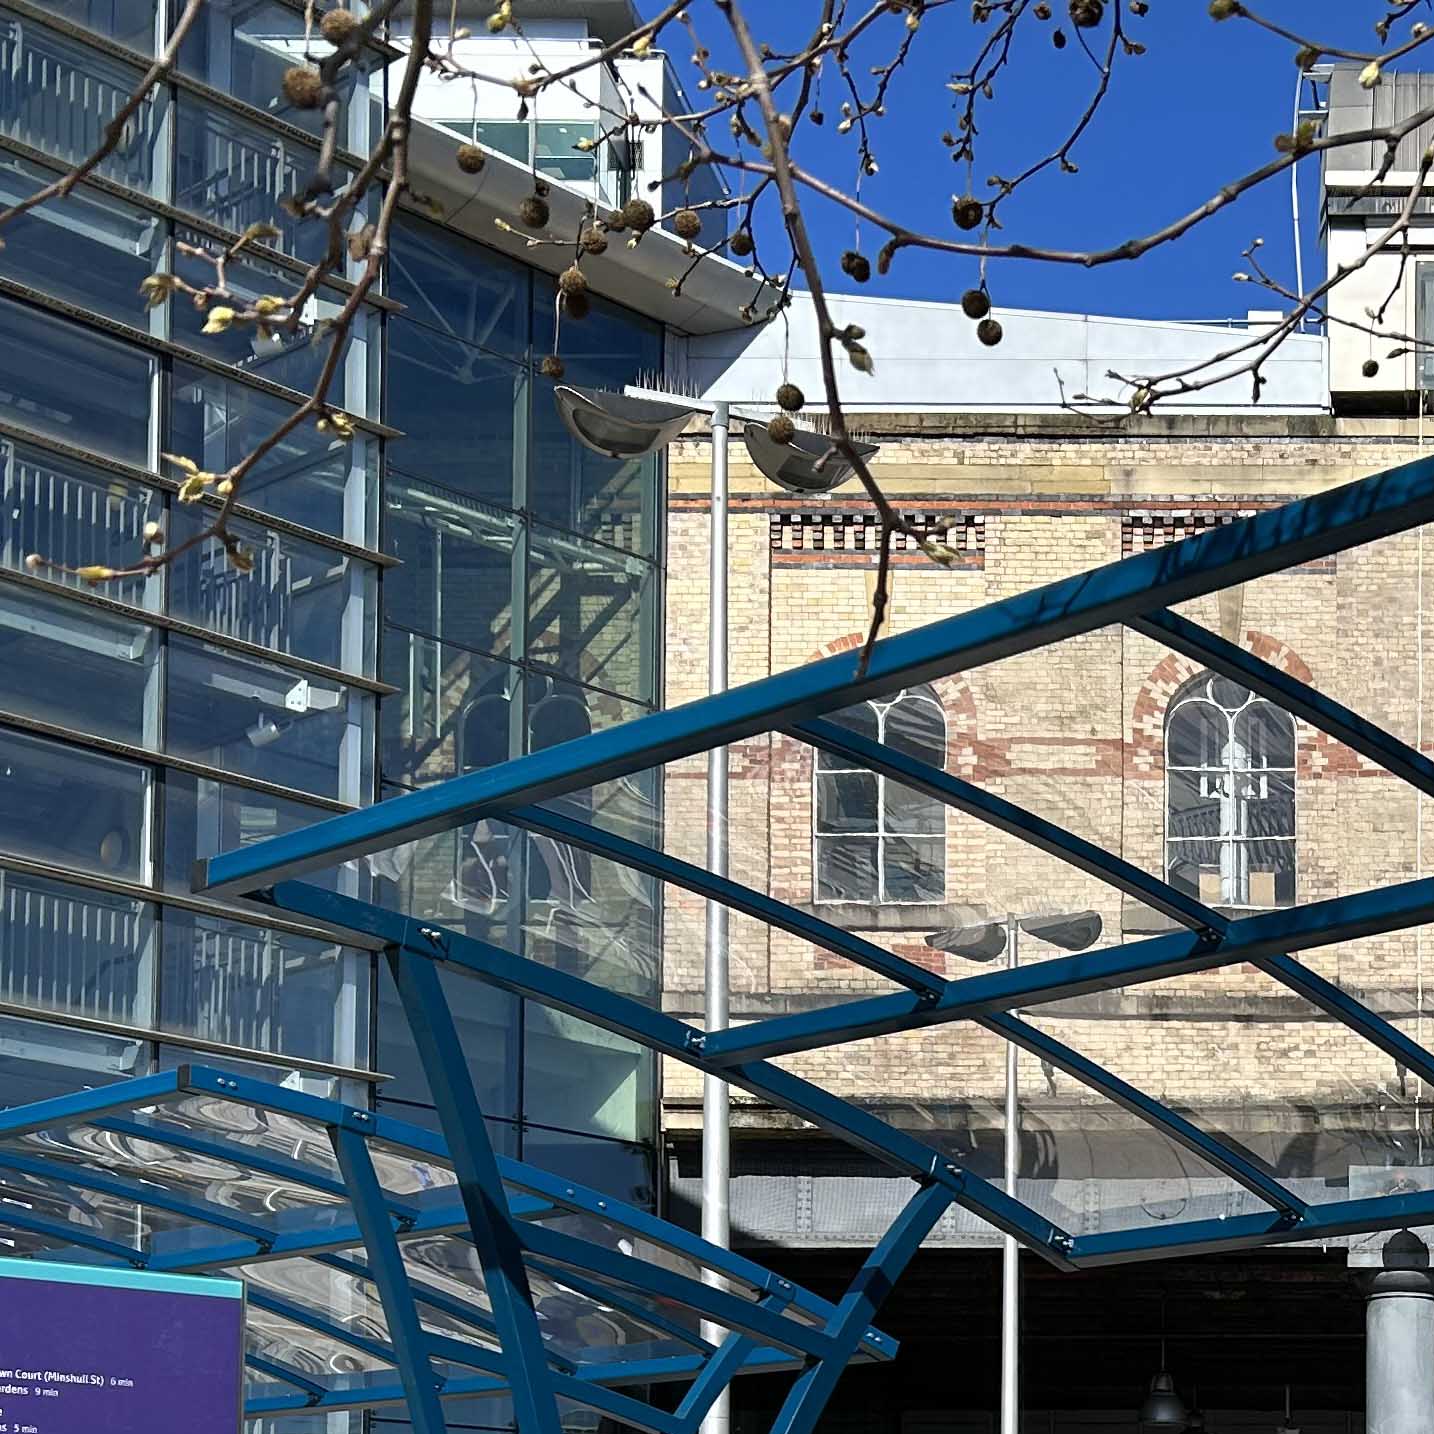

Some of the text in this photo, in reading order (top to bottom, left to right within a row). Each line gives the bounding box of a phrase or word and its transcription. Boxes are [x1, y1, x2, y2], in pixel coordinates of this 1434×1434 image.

[15, 1369, 42, 1380] Court
[110, 1376, 117, 1386] 6
[117, 1378, 134, 1387] min
[34, 1387, 41, 1396] 9
[42, 1388, 59, 1397] min
[21, 1425, 38, 1434] min
